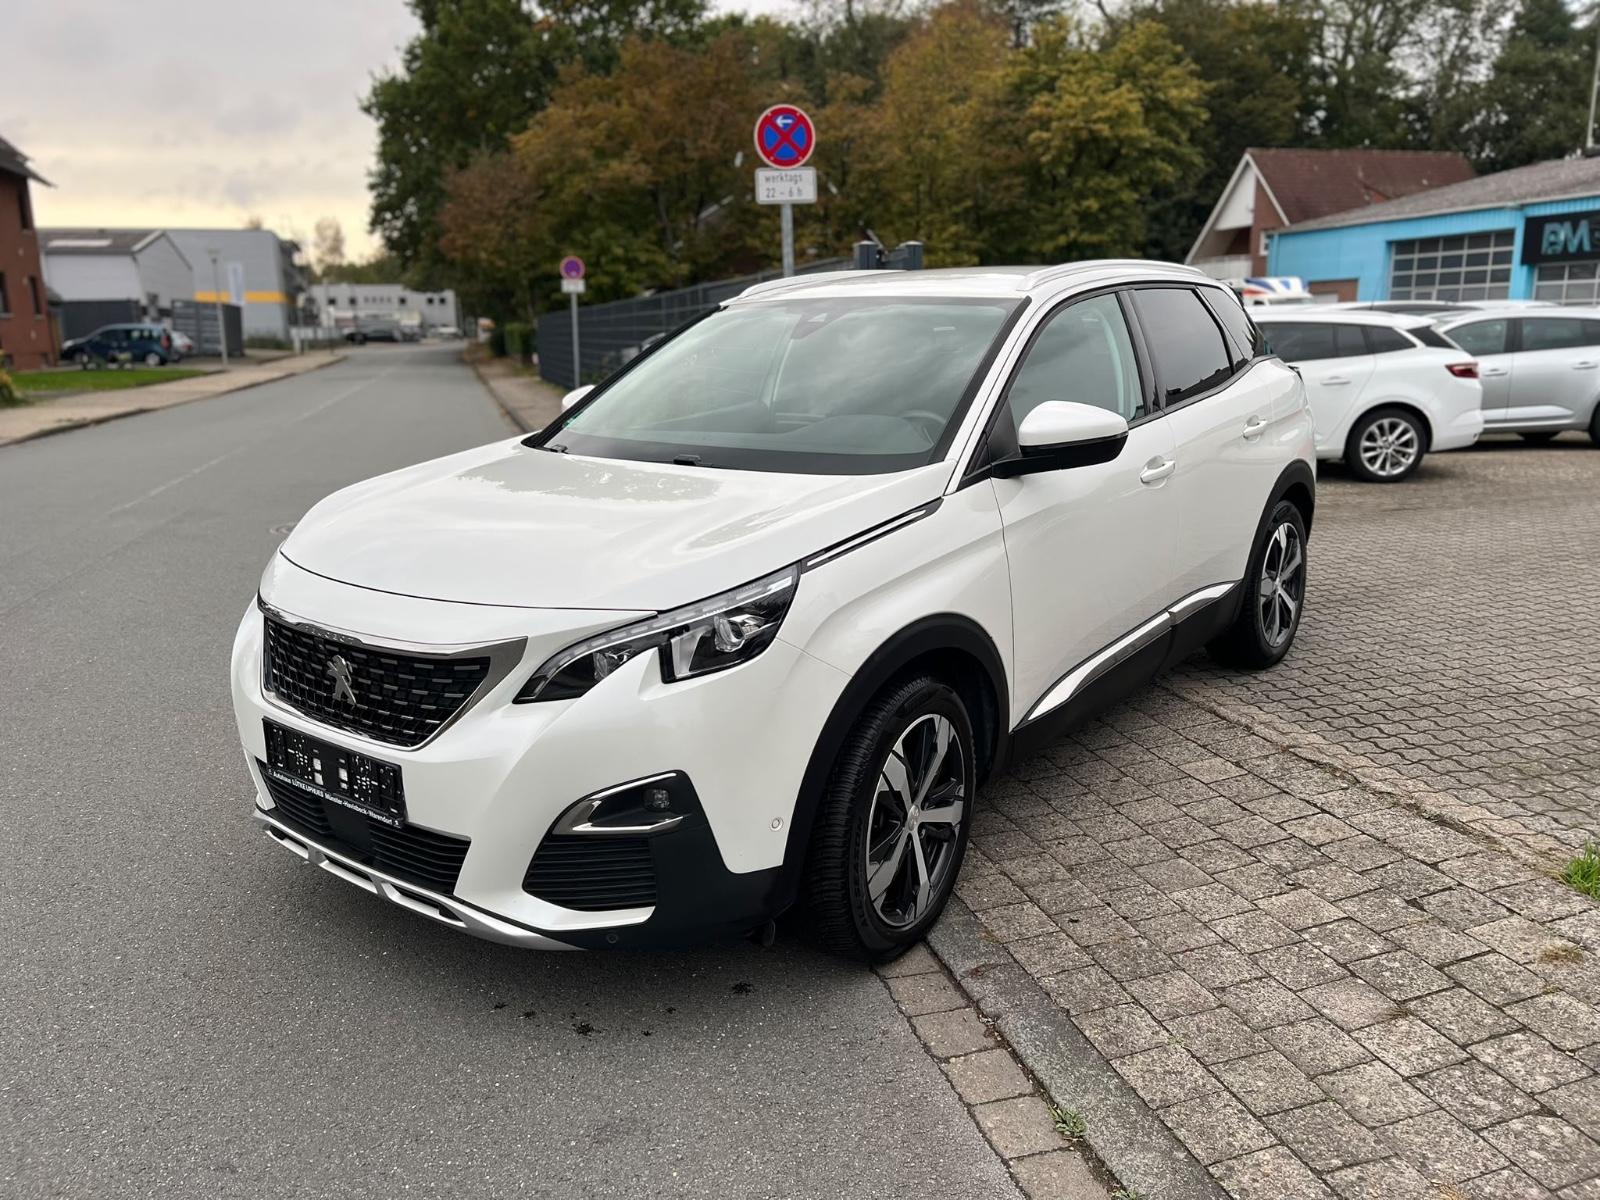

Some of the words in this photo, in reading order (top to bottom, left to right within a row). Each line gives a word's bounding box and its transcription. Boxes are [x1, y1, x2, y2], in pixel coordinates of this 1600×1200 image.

[764, 173, 803, 185] werktags
[765, 187, 776, 198] 22
[273, 771, 292, 784] Autohaus
